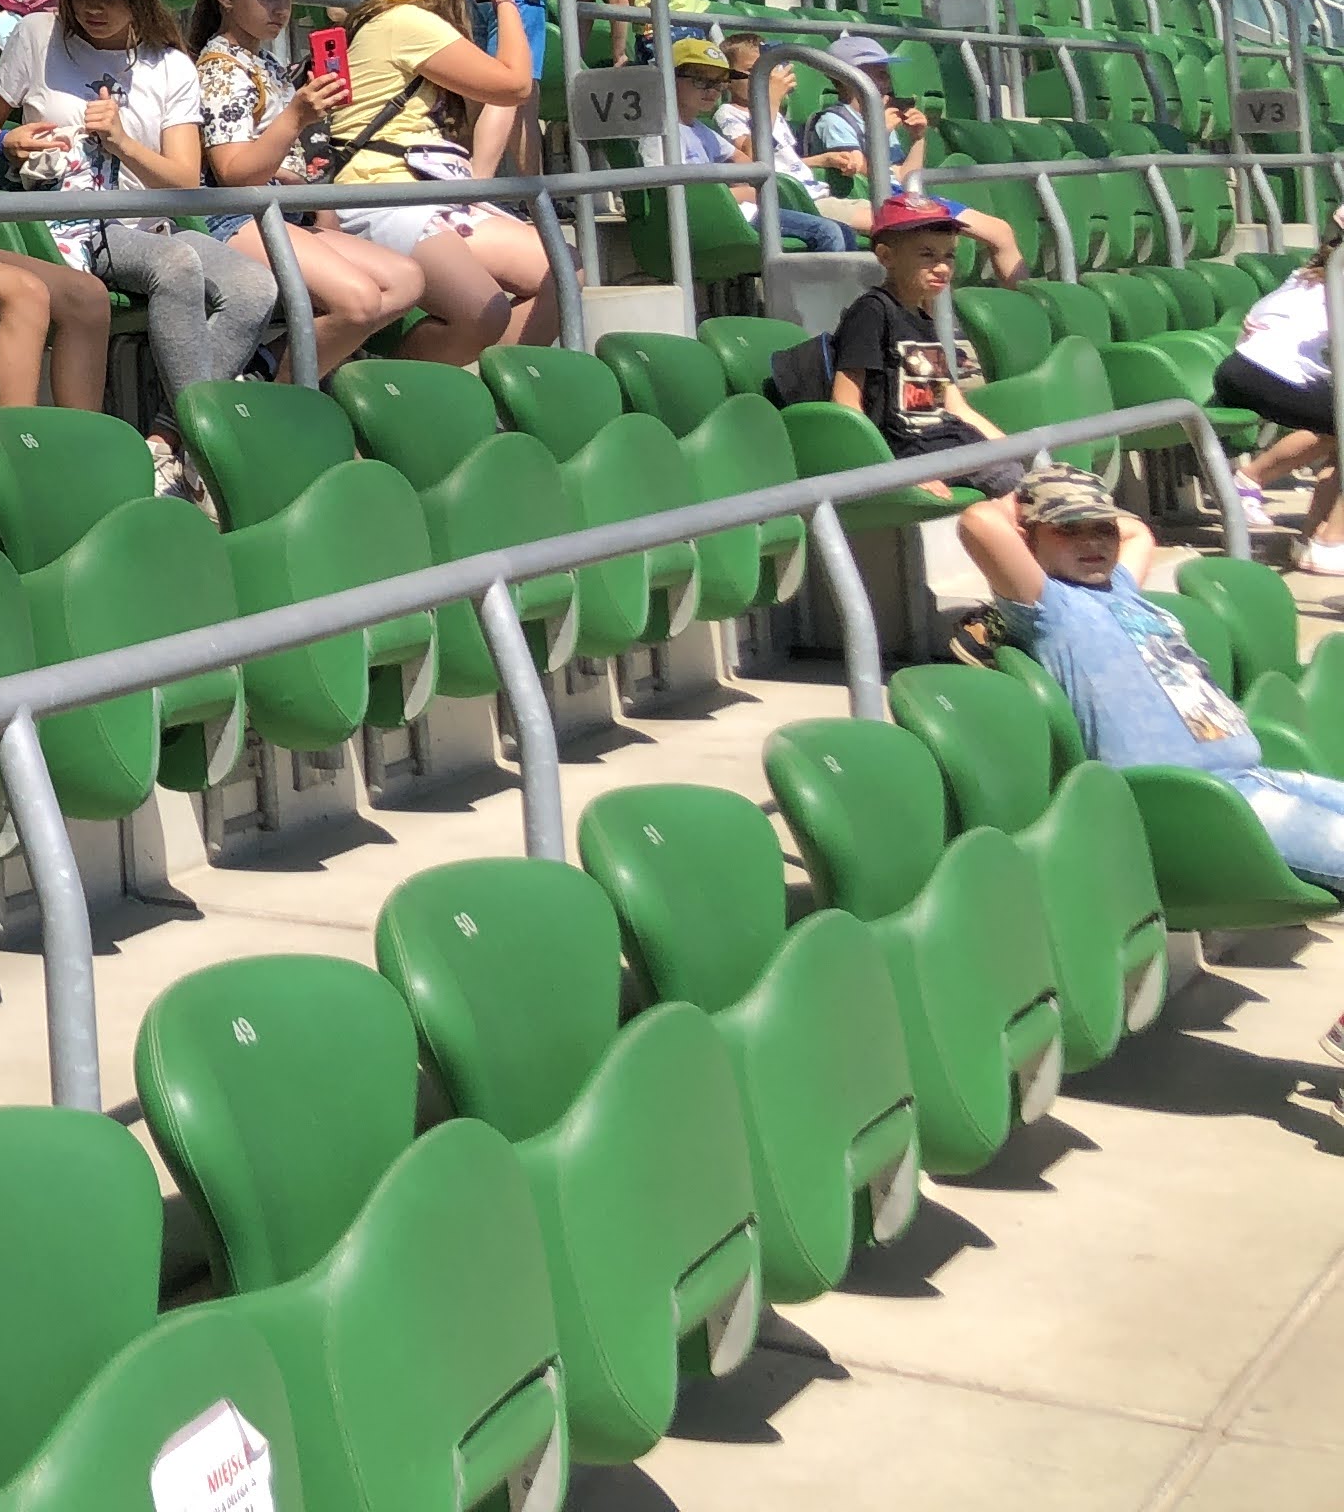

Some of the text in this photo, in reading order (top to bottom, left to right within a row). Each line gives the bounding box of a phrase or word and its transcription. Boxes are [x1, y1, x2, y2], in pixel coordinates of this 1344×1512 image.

[590, 90, 642, 123] V3
[1247, 103, 1286, 124] V3
[454, 912, 478, 937] 50
[232, 1017, 257, 1046] 49
